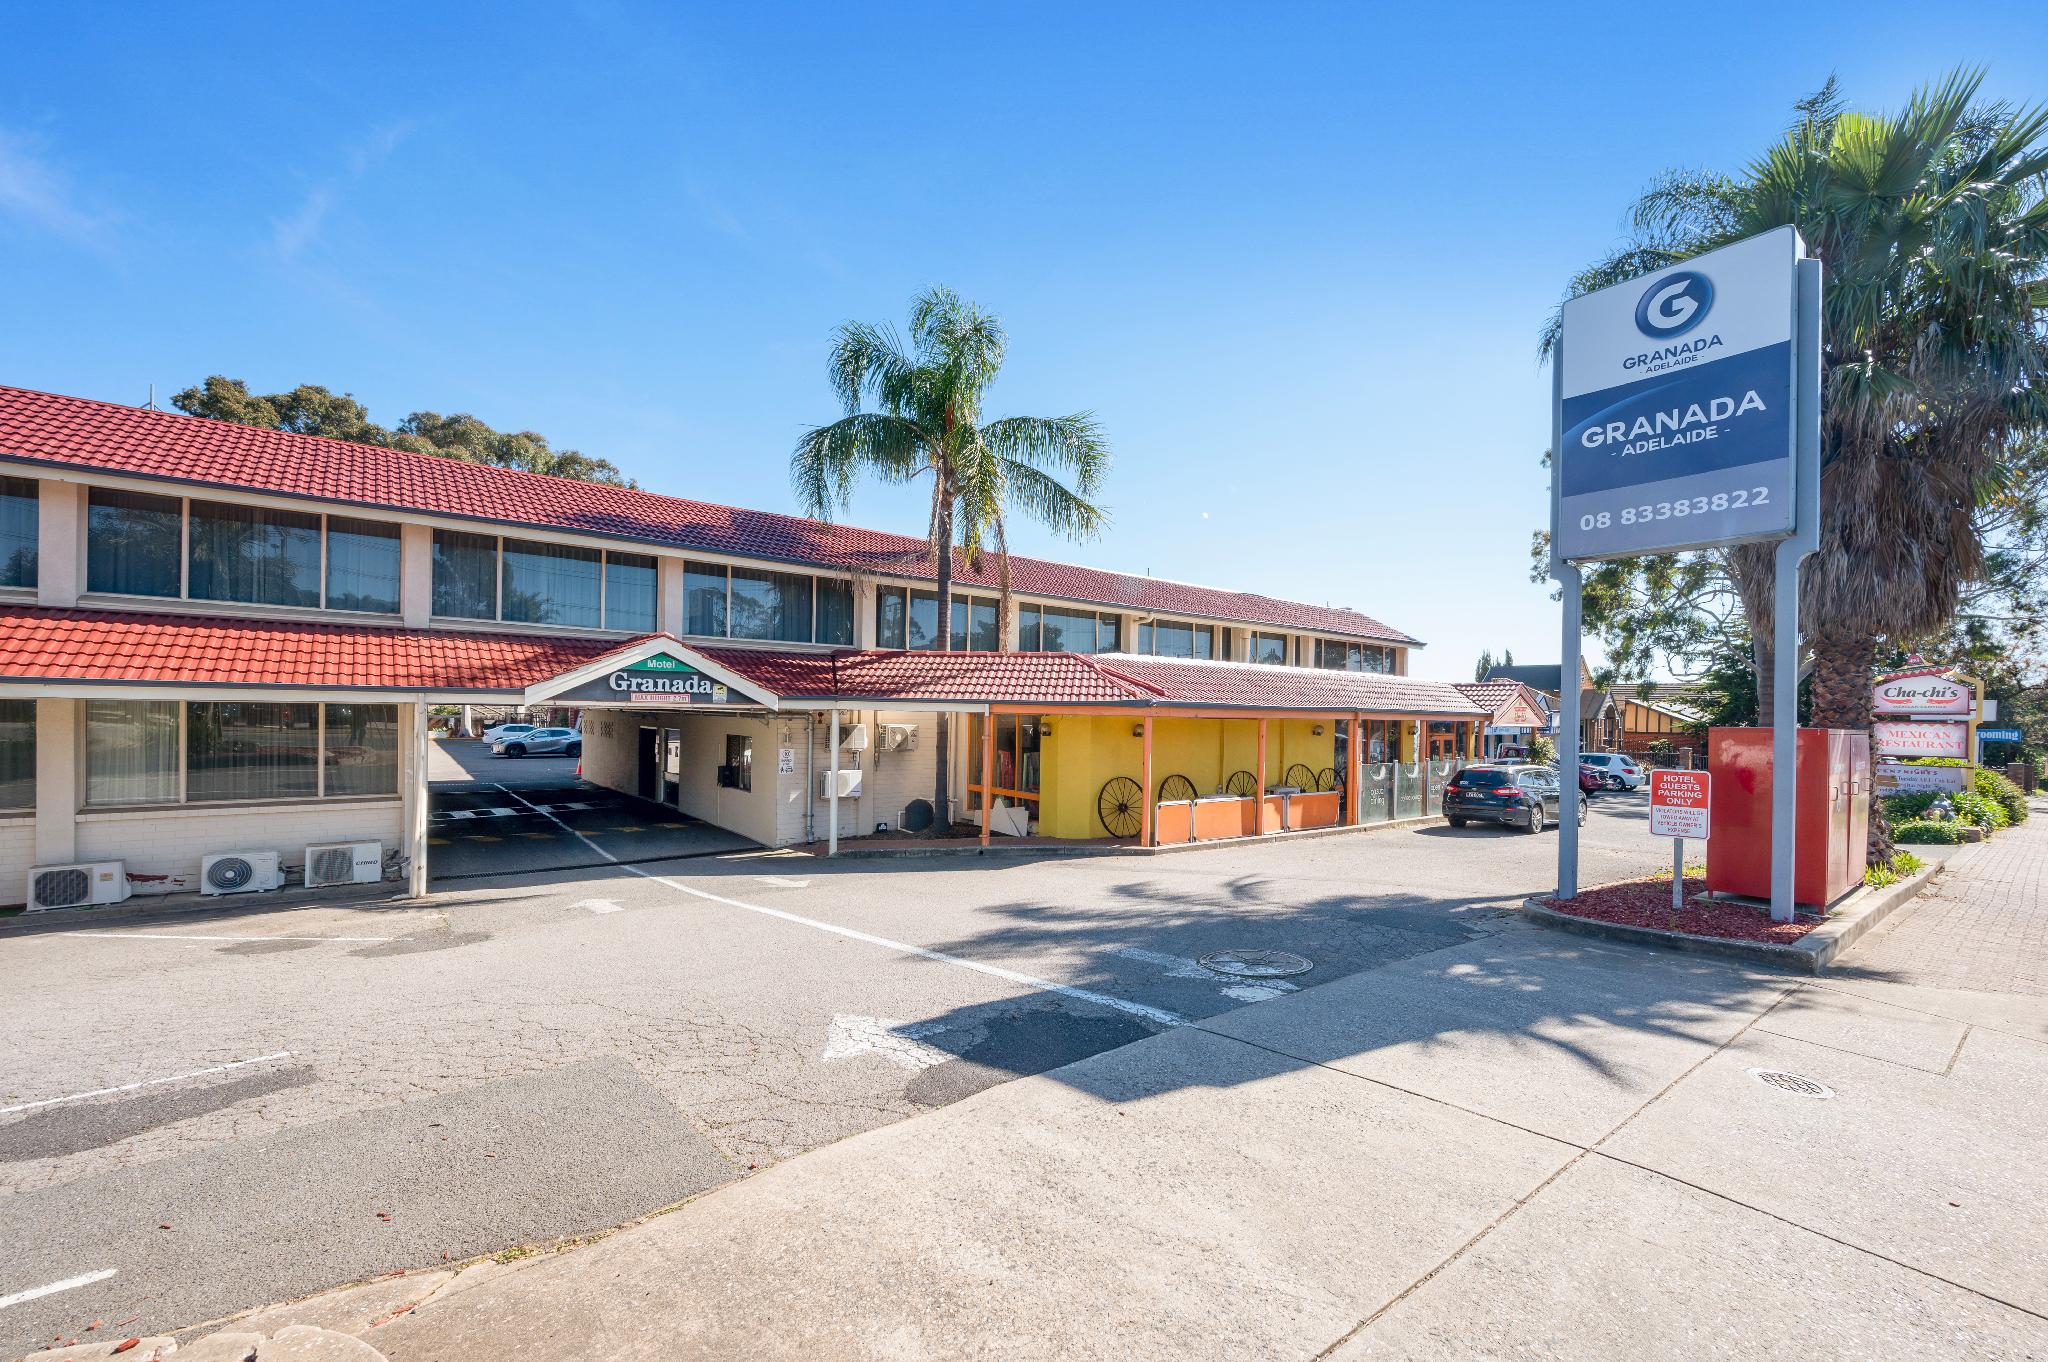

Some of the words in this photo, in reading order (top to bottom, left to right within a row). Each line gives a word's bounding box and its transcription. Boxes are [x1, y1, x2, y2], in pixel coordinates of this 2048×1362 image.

[1622, 334, 1723, 370] GRANADA
[1645, 354, 1699, 374] ADELAIDE
[1581, 390, 1767, 448] GRANADA
[1621, 426, 1718, 457] ADELAIDE
[1580, 511, 1612, 531] 08
[1620, 486, 1770, 526] 83383822
[647, 659, 676, 668] Motel
[609, 671, 714, 694] Granada
[1884, 686, 1959, 698] Cha-chi's
[1888, 730, 1951, 739] MEXICAN
[1976, 730, 2019, 741] rooming
[1878, 739, 1963, 750] RESTAURANT
[1663, 775, 1696, 783] HOTEL
[1660, 782, 1700, 791] GUESTS
[1658, 790, 1702, 798] PARKING
[1666, 797, 1692, 806] ONLY
